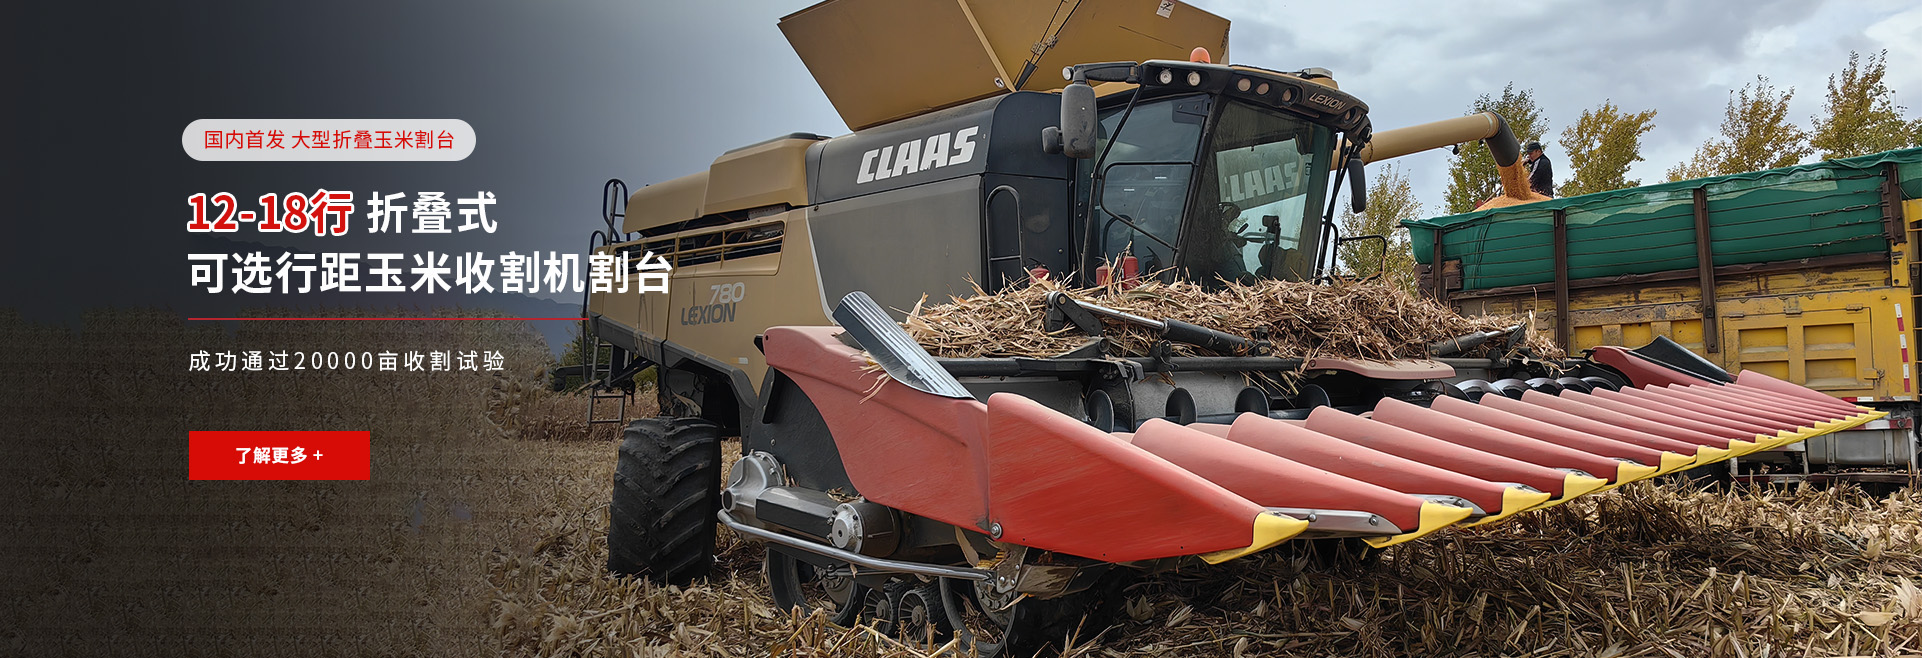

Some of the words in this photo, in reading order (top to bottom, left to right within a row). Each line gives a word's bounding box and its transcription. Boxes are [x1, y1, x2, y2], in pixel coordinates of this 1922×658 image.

[1309, 93, 1346, 110] LEXION
[856, 125, 979, 184] CLAAS
[709, 282, 745, 305] 780
[681, 302, 736, 326] LEXION
